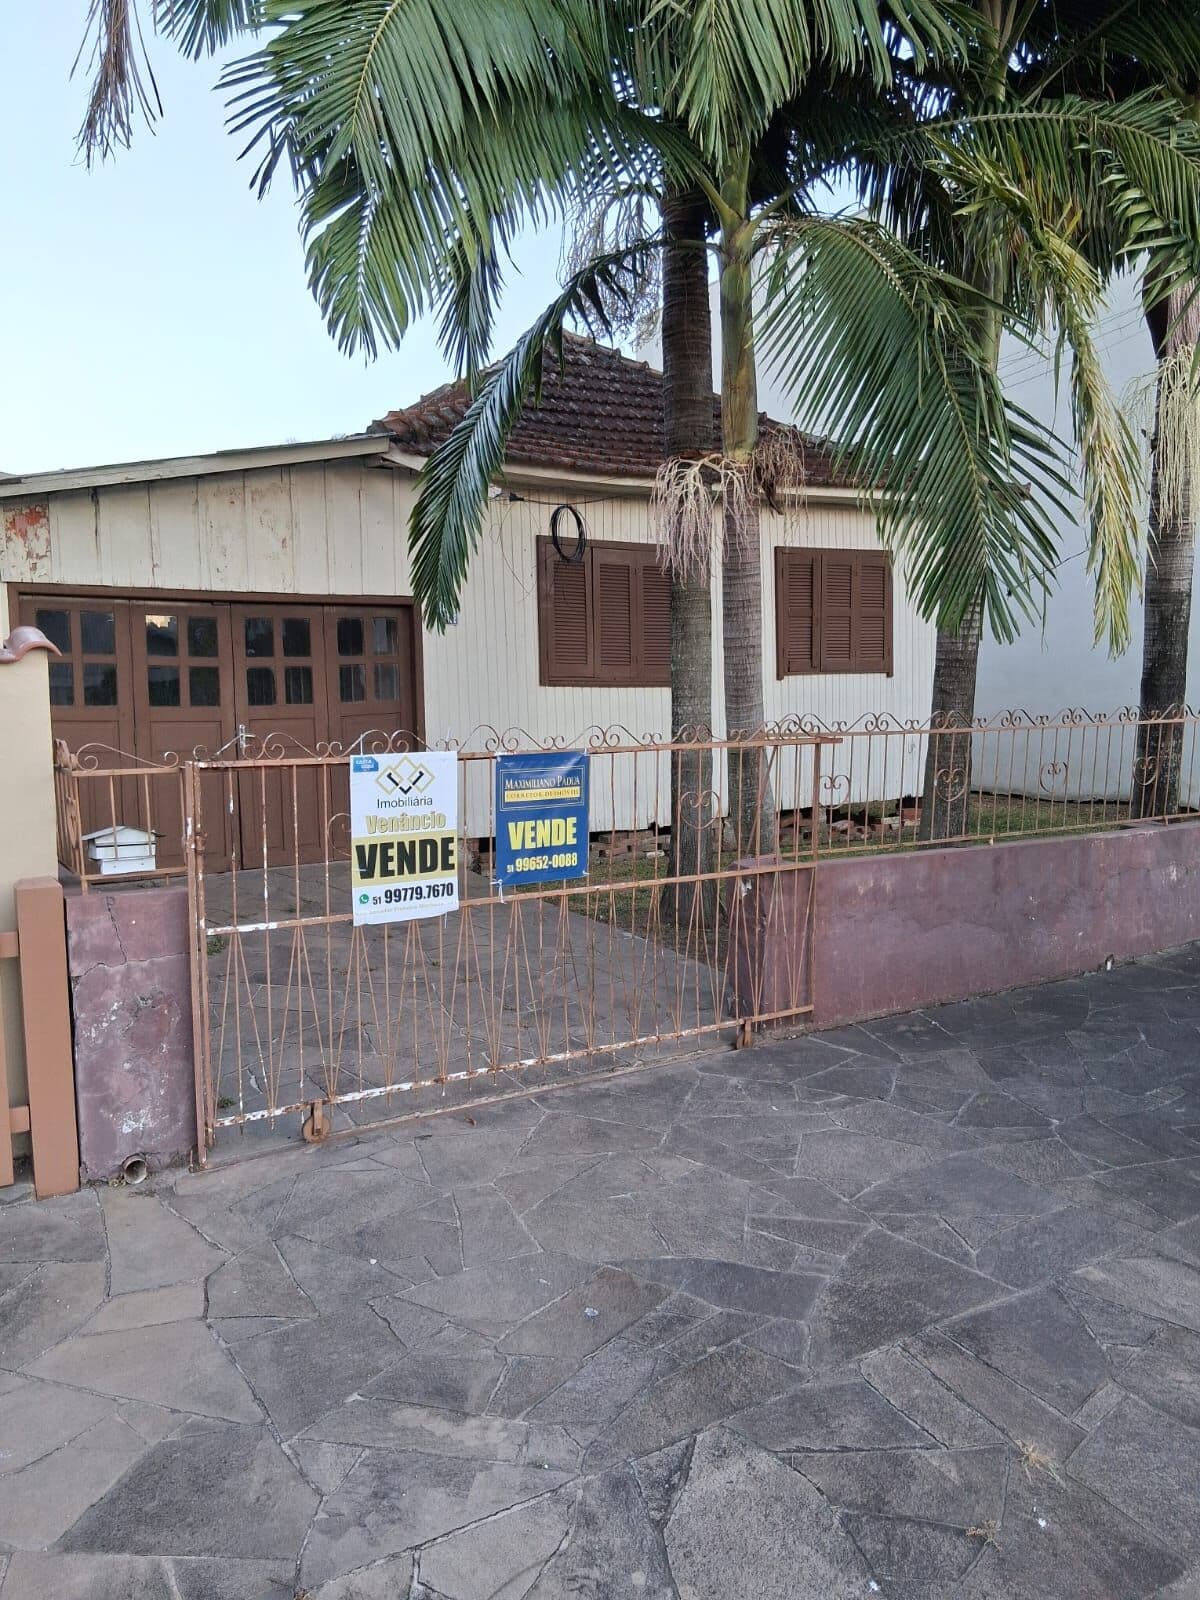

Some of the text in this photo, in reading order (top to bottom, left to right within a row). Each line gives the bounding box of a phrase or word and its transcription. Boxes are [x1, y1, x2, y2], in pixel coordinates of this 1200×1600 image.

[505, 777, 556, 790] MAXIMILIANO
[377, 796, 433, 810] Imobiliária
[365, 811, 446, 834] Venâncio
[508, 817, 577, 851] VENDE
[355, 837, 456, 880] VENDE
[515, 852, 578, 873] 99652-0088
[372, 882, 454, 905] 51 99779.7670
